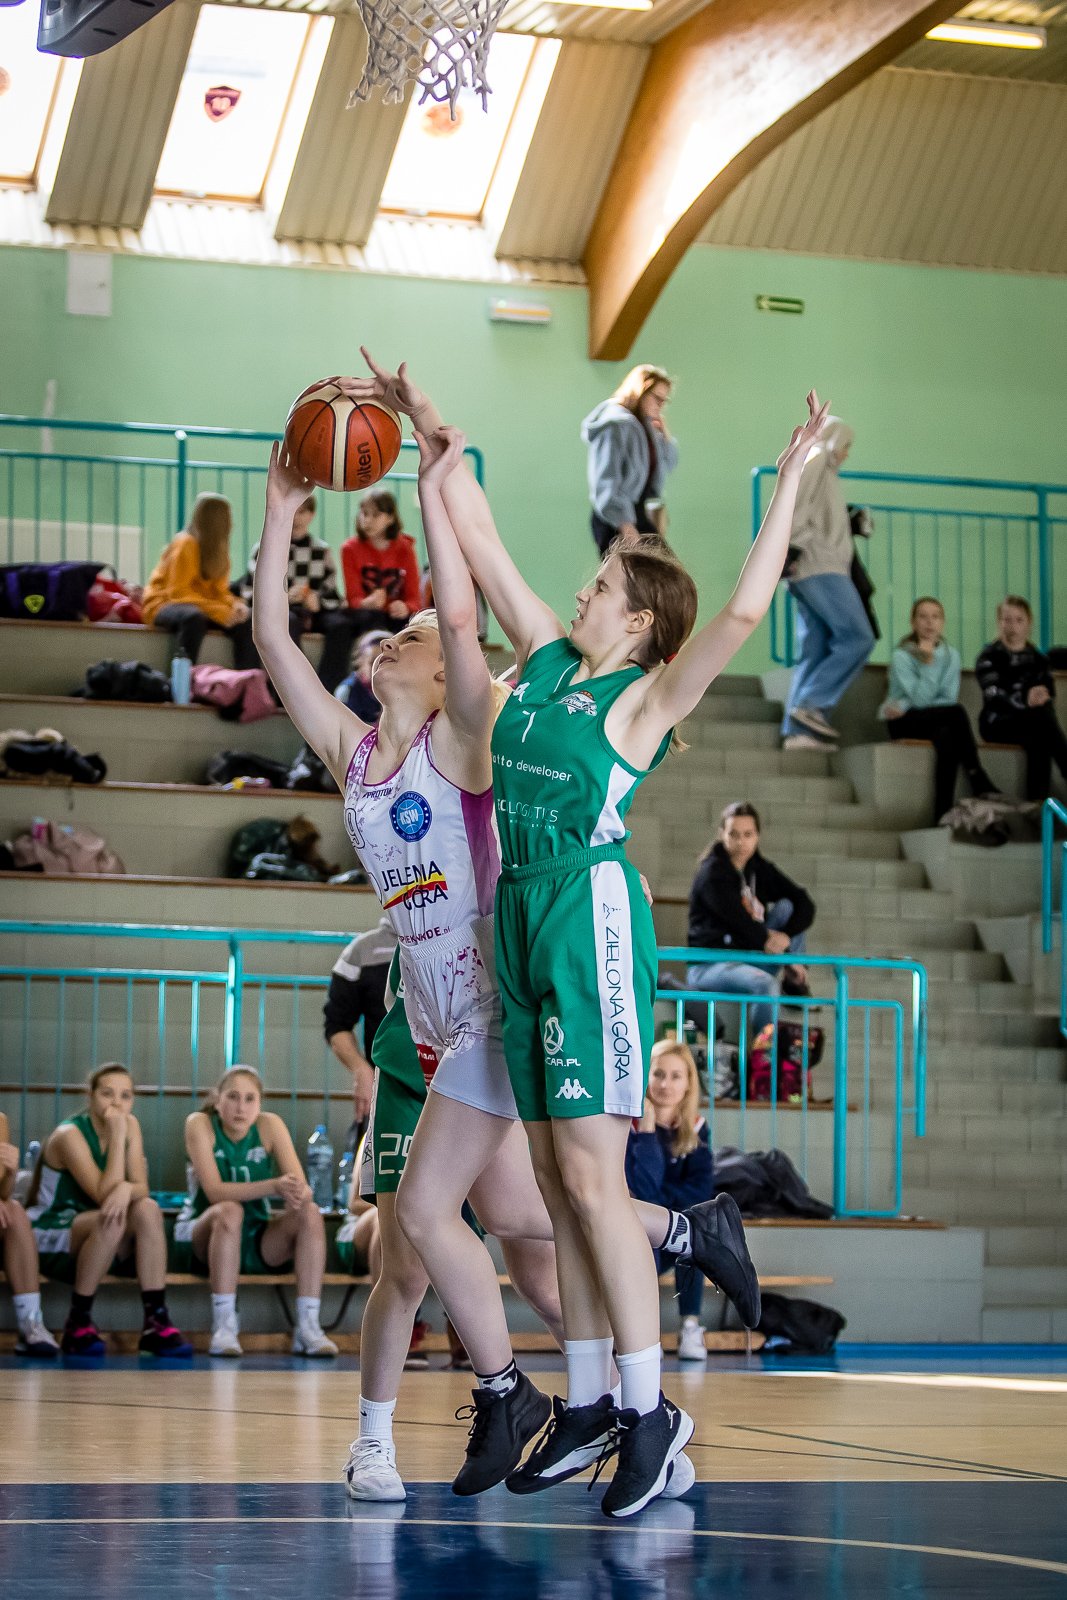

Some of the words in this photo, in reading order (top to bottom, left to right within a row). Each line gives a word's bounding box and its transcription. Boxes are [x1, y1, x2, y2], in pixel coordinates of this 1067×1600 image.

[516, 759, 572, 782] deweloper
[403, 884, 449, 911] GÓRA
[605, 926, 625, 1019] ZIELONA
[611, 1021, 633, 1083] GÓRA
